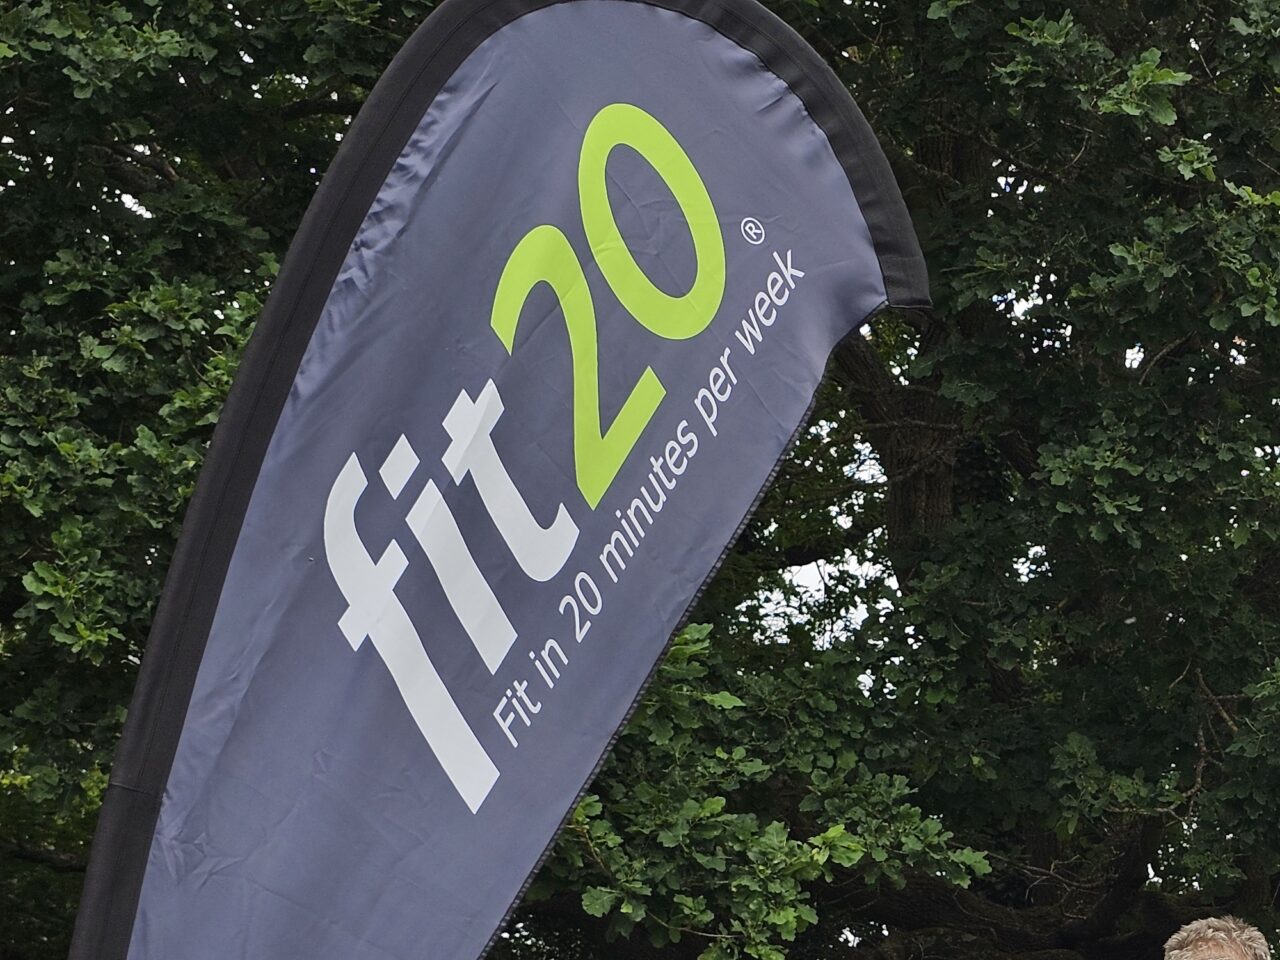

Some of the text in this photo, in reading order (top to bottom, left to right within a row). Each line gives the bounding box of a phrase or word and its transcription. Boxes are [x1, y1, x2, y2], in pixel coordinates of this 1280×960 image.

[323, 103, 727, 815] fit20
[493, 249, 805, 748] Fit in 20 minutes per week
